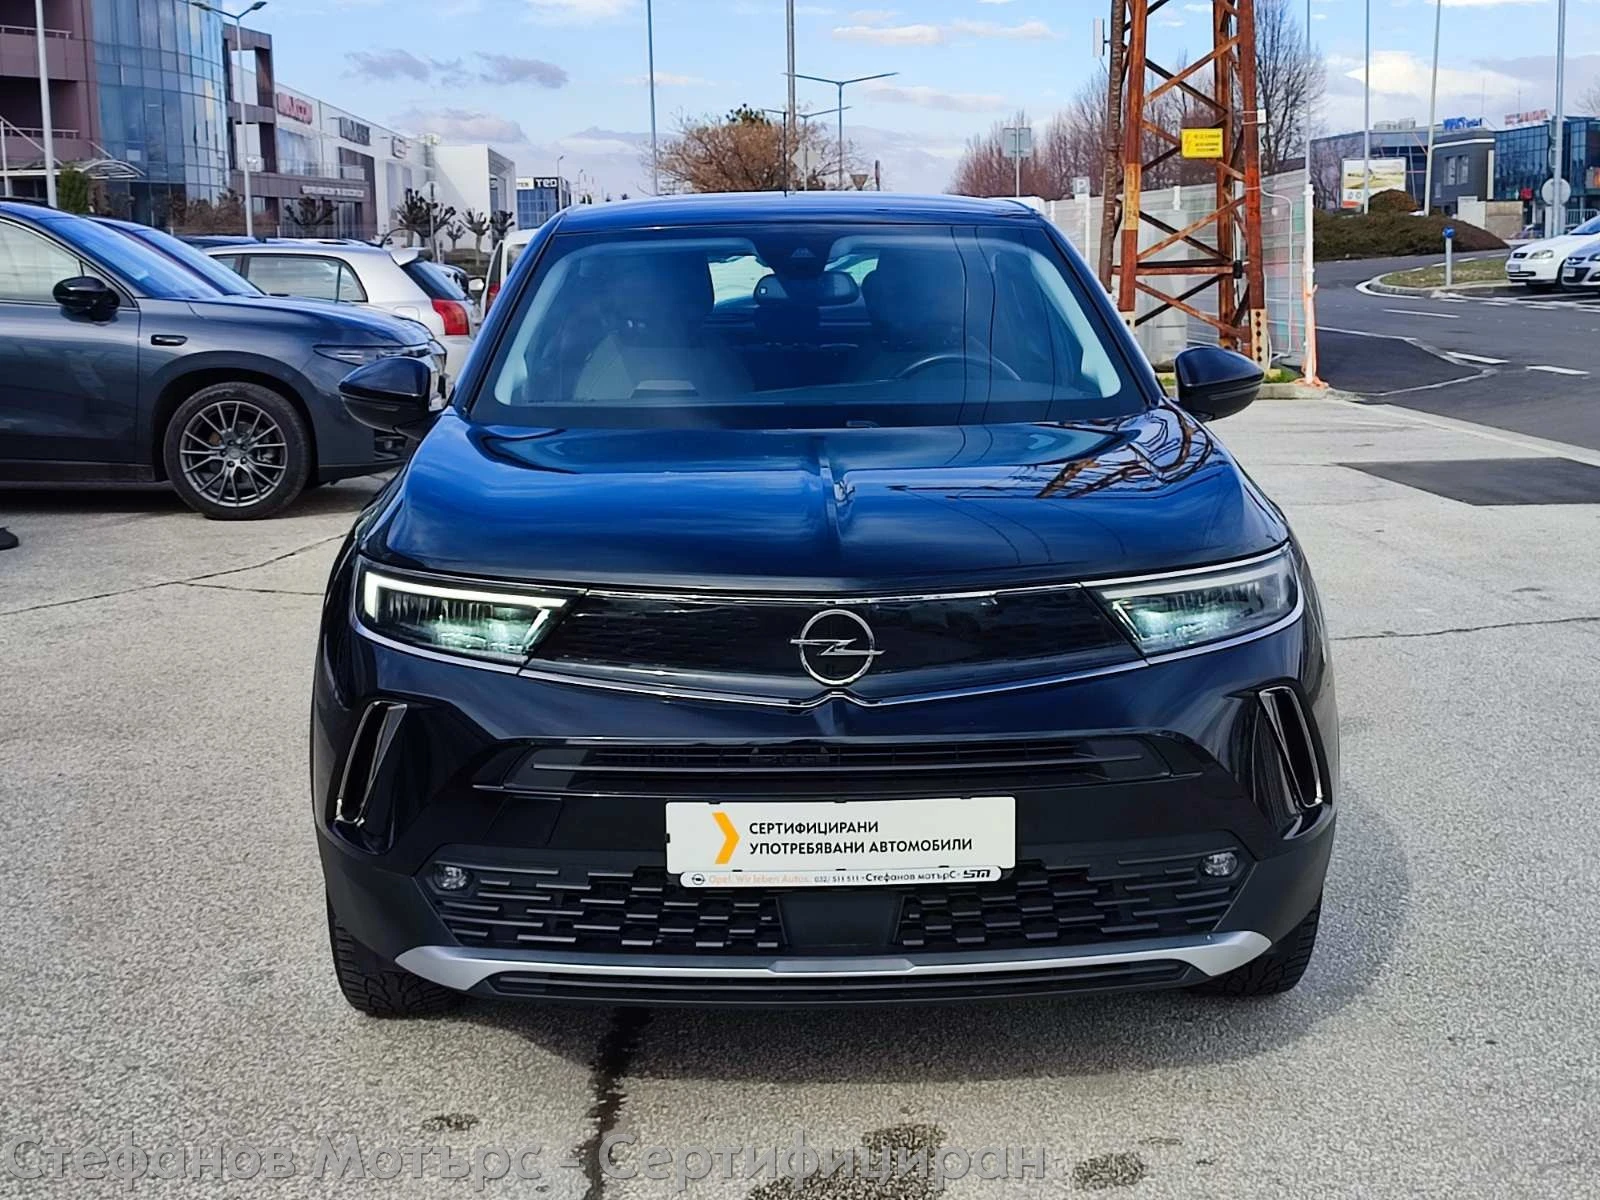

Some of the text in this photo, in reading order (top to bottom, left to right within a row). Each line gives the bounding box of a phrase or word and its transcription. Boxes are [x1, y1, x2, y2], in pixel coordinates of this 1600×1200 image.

[749, 821, 879, 835] СЕРТИФИЦИРАНИ
[750, 838, 973, 855] УПОТРЕБЯВАНИ АВТОМОБИЛИ
